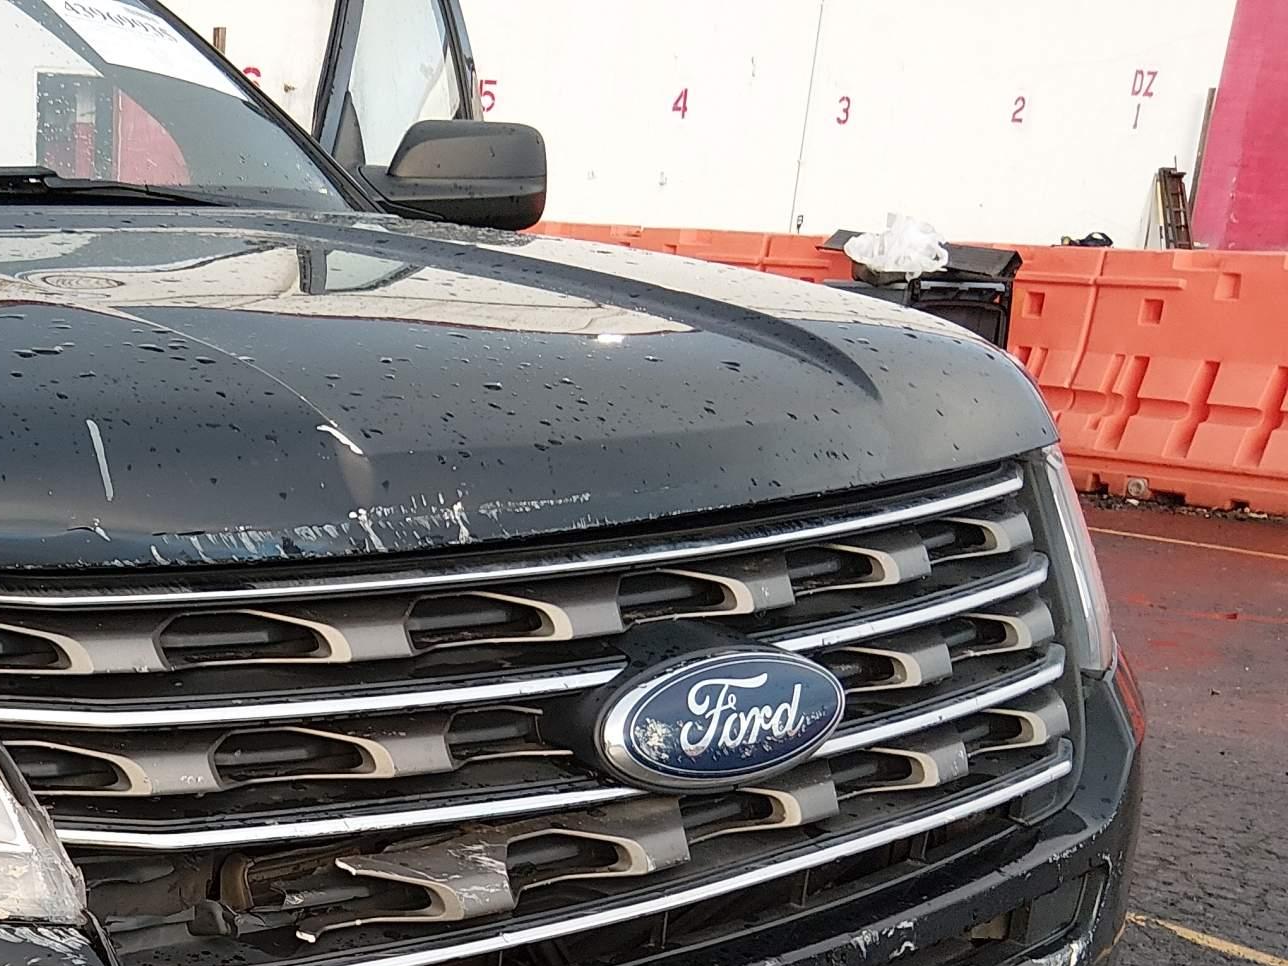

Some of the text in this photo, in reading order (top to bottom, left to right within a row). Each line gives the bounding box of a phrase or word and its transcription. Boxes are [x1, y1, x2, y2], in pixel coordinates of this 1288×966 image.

[64, 0, 178, 43] 43969935
[479, 79, 497, 112] 5
[1131, 69, 1159, 98] DZ
[672, 87, 689, 120] 4
[835, 95, 851, 125] 3
[1011, 95, 1026, 124] 2
[679, 673, 804, 757] Ford
